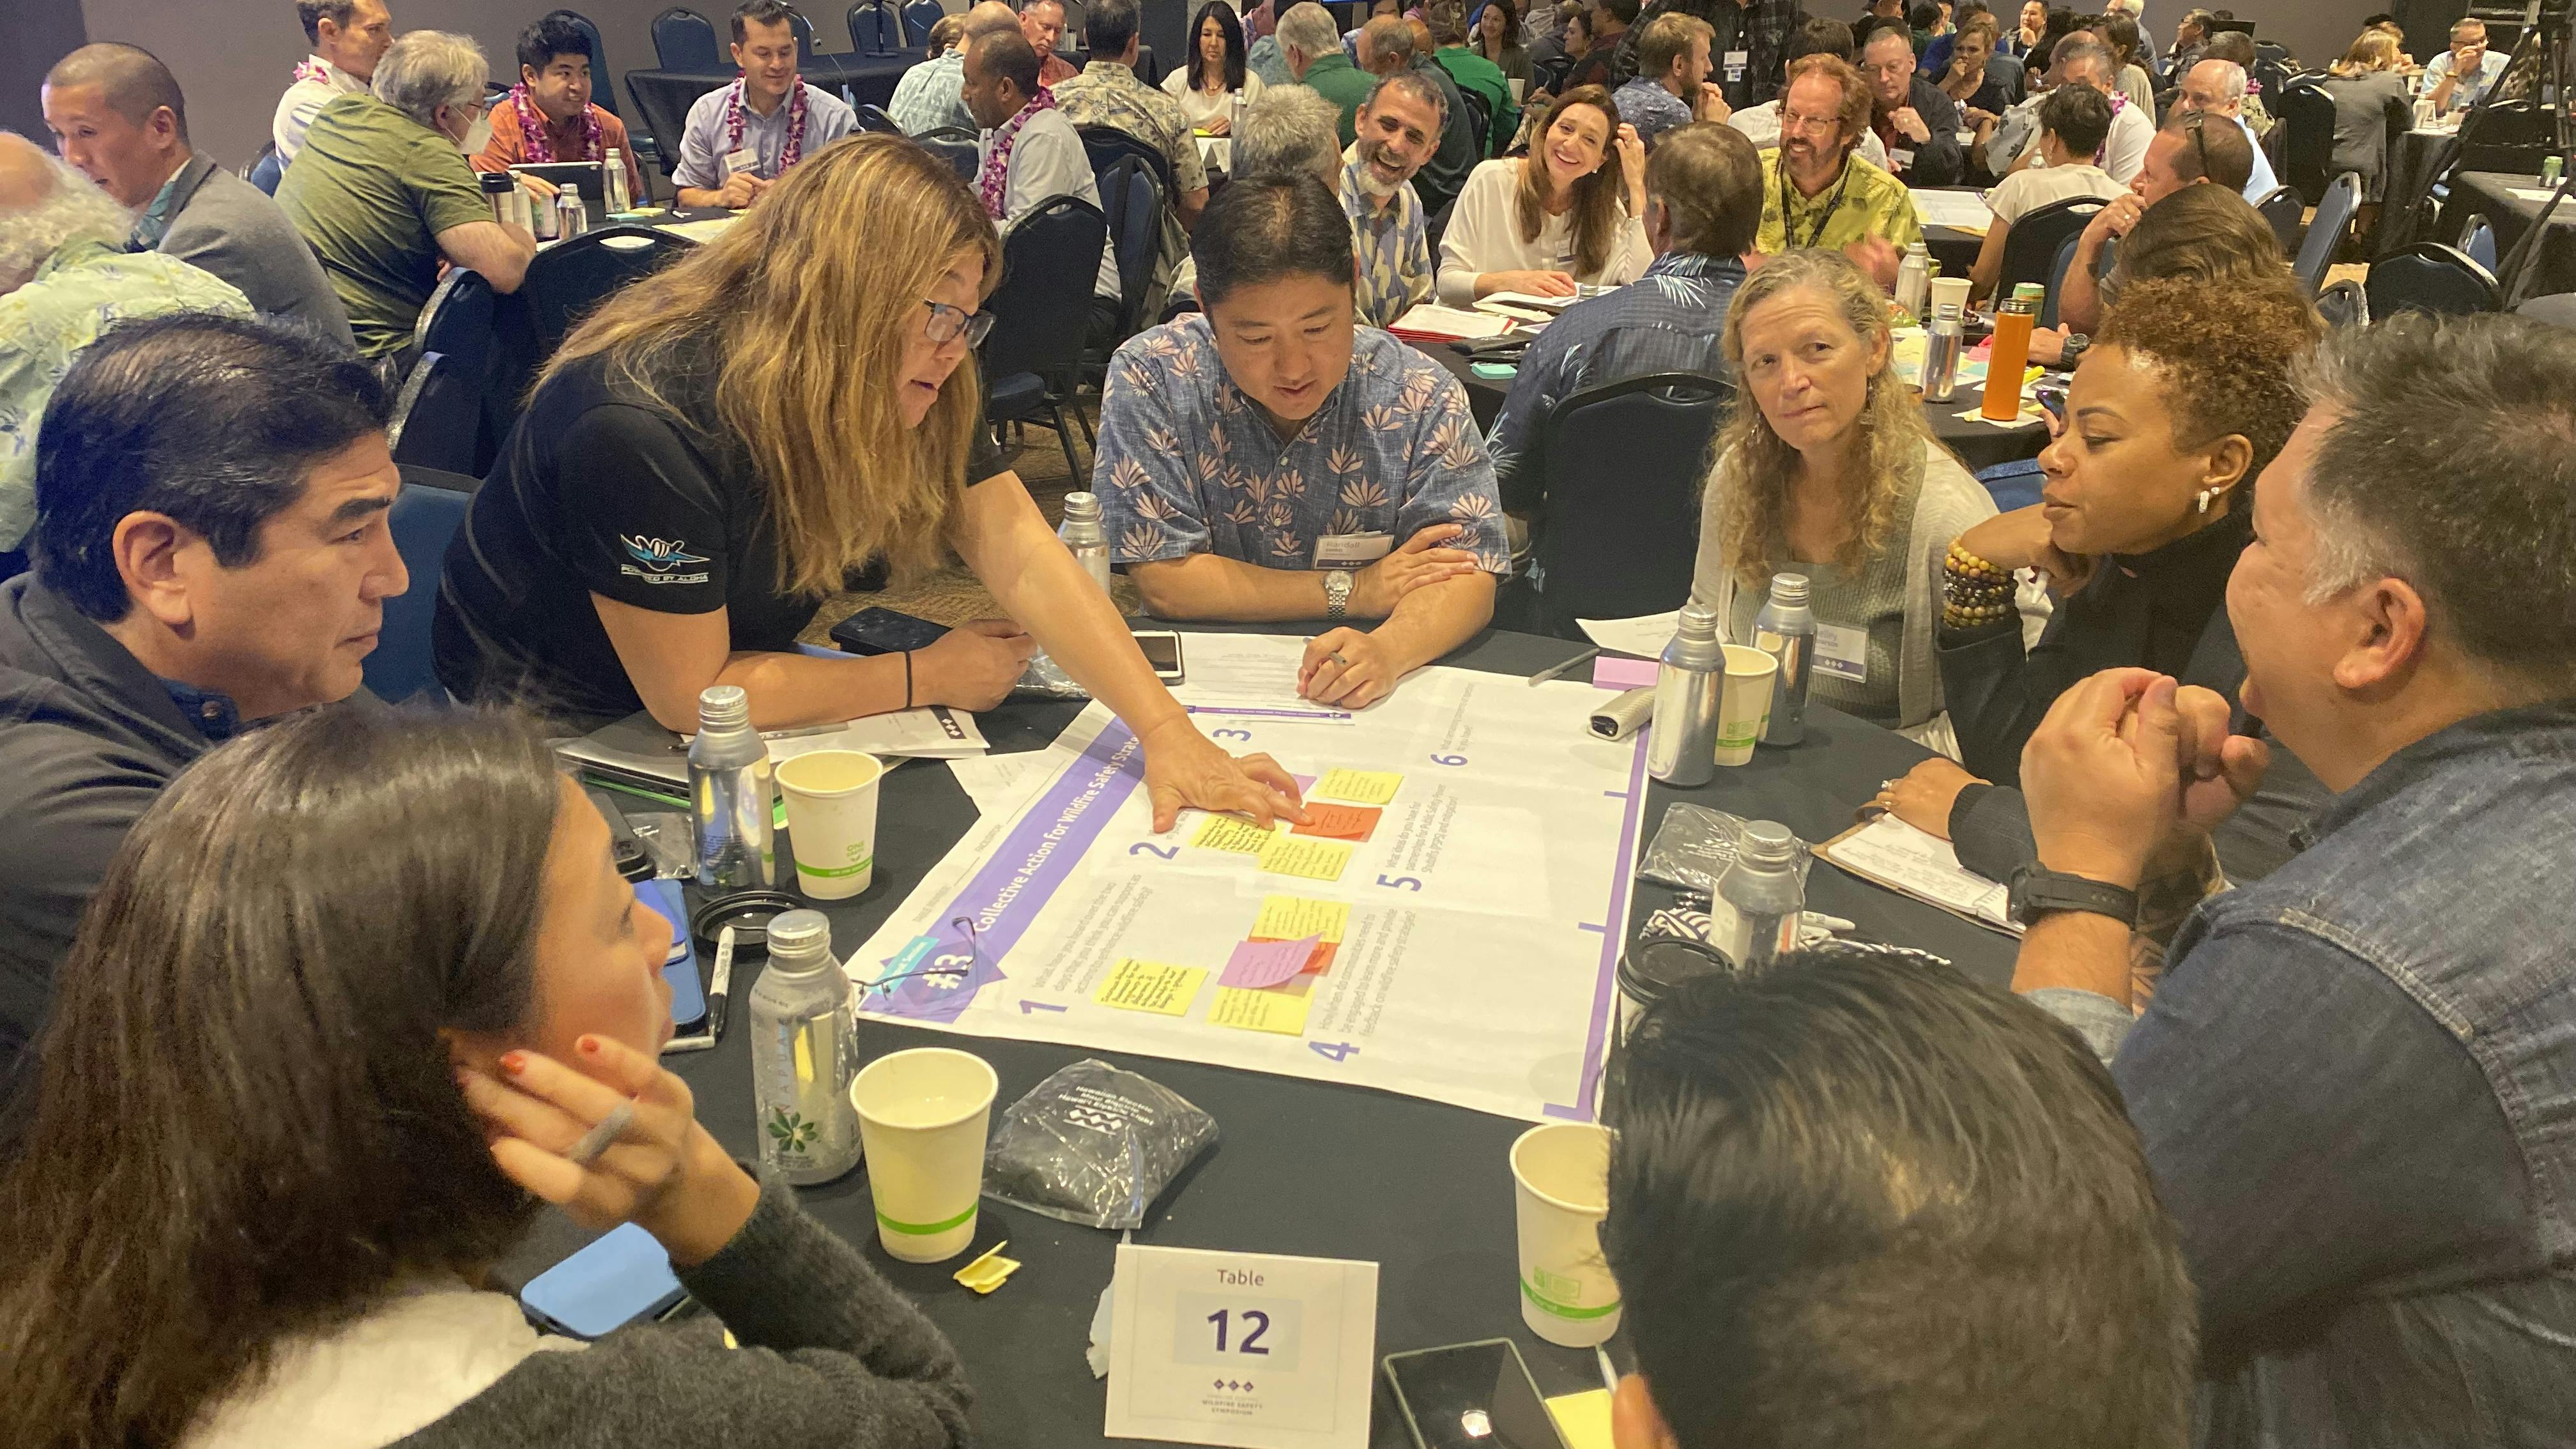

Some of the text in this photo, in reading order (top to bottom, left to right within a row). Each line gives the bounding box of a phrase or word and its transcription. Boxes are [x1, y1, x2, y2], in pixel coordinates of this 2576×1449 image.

[1213, 728, 1252, 742] 3
[1430, 754, 1468, 766] 6
[1432, 783, 1446, 798] Power
[1426, 798, 1443, 813] Safety
[1405, 809, 1419, 821] have
[1420, 814, 1435, 829] Public
[973, 737, 1139, 931] Collective Action for Wildfire Safety Strate
[1403, 822, 1414, 832] you
[1438, 822, 1449, 833] and
[1129, 842, 1180, 859] 2
[1393, 839, 1407, 853] ideas
[1385, 853, 1401, 868] What
[1376, 874, 1422, 892] 5
[1092, 894, 1108, 905] the
[1117, 907, 1139, 931] wildfire
[1054, 973, 1073, 991] days
[1078, 947, 1092, 960] you
[1085, 930, 1104, 946] think
[1098, 918, 1112, 930] you
[1107, 905, 1119, 917] can
[1114, 882, 1137, 905] support
[1067, 919, 1089, 939] heard
[1061, 940, 1076, 953] you
[1334, 980, 1348, 990] do
[1358, 920, 1373, 938] need
[1046, 953, 1066, 967] have
[922, 954, 973, 990] #3
[1032, 968, 1055, 988] What
[1346, 990, 1366, 1023] engaged
[1376, 931, 1389, 946] and
[1359, 1004, 1383, 1036] feedback
[1387, 945, 1407, 969] safety
[1019, 1000, 1068, 1014] 1
[1308, 1041, 1360, 1062] 4
[1076, 1086, 1154, 1113] Hawaiian Electric
[1105, 1098, 1139, 1113] Electric
[1093, 1101, 1128, 1115] Electric
[1130, 1112, 1154, 1126] Light
[1217, 1269, 1264, 1287] Table
[1208, 1309, 1271, 1355] 12
